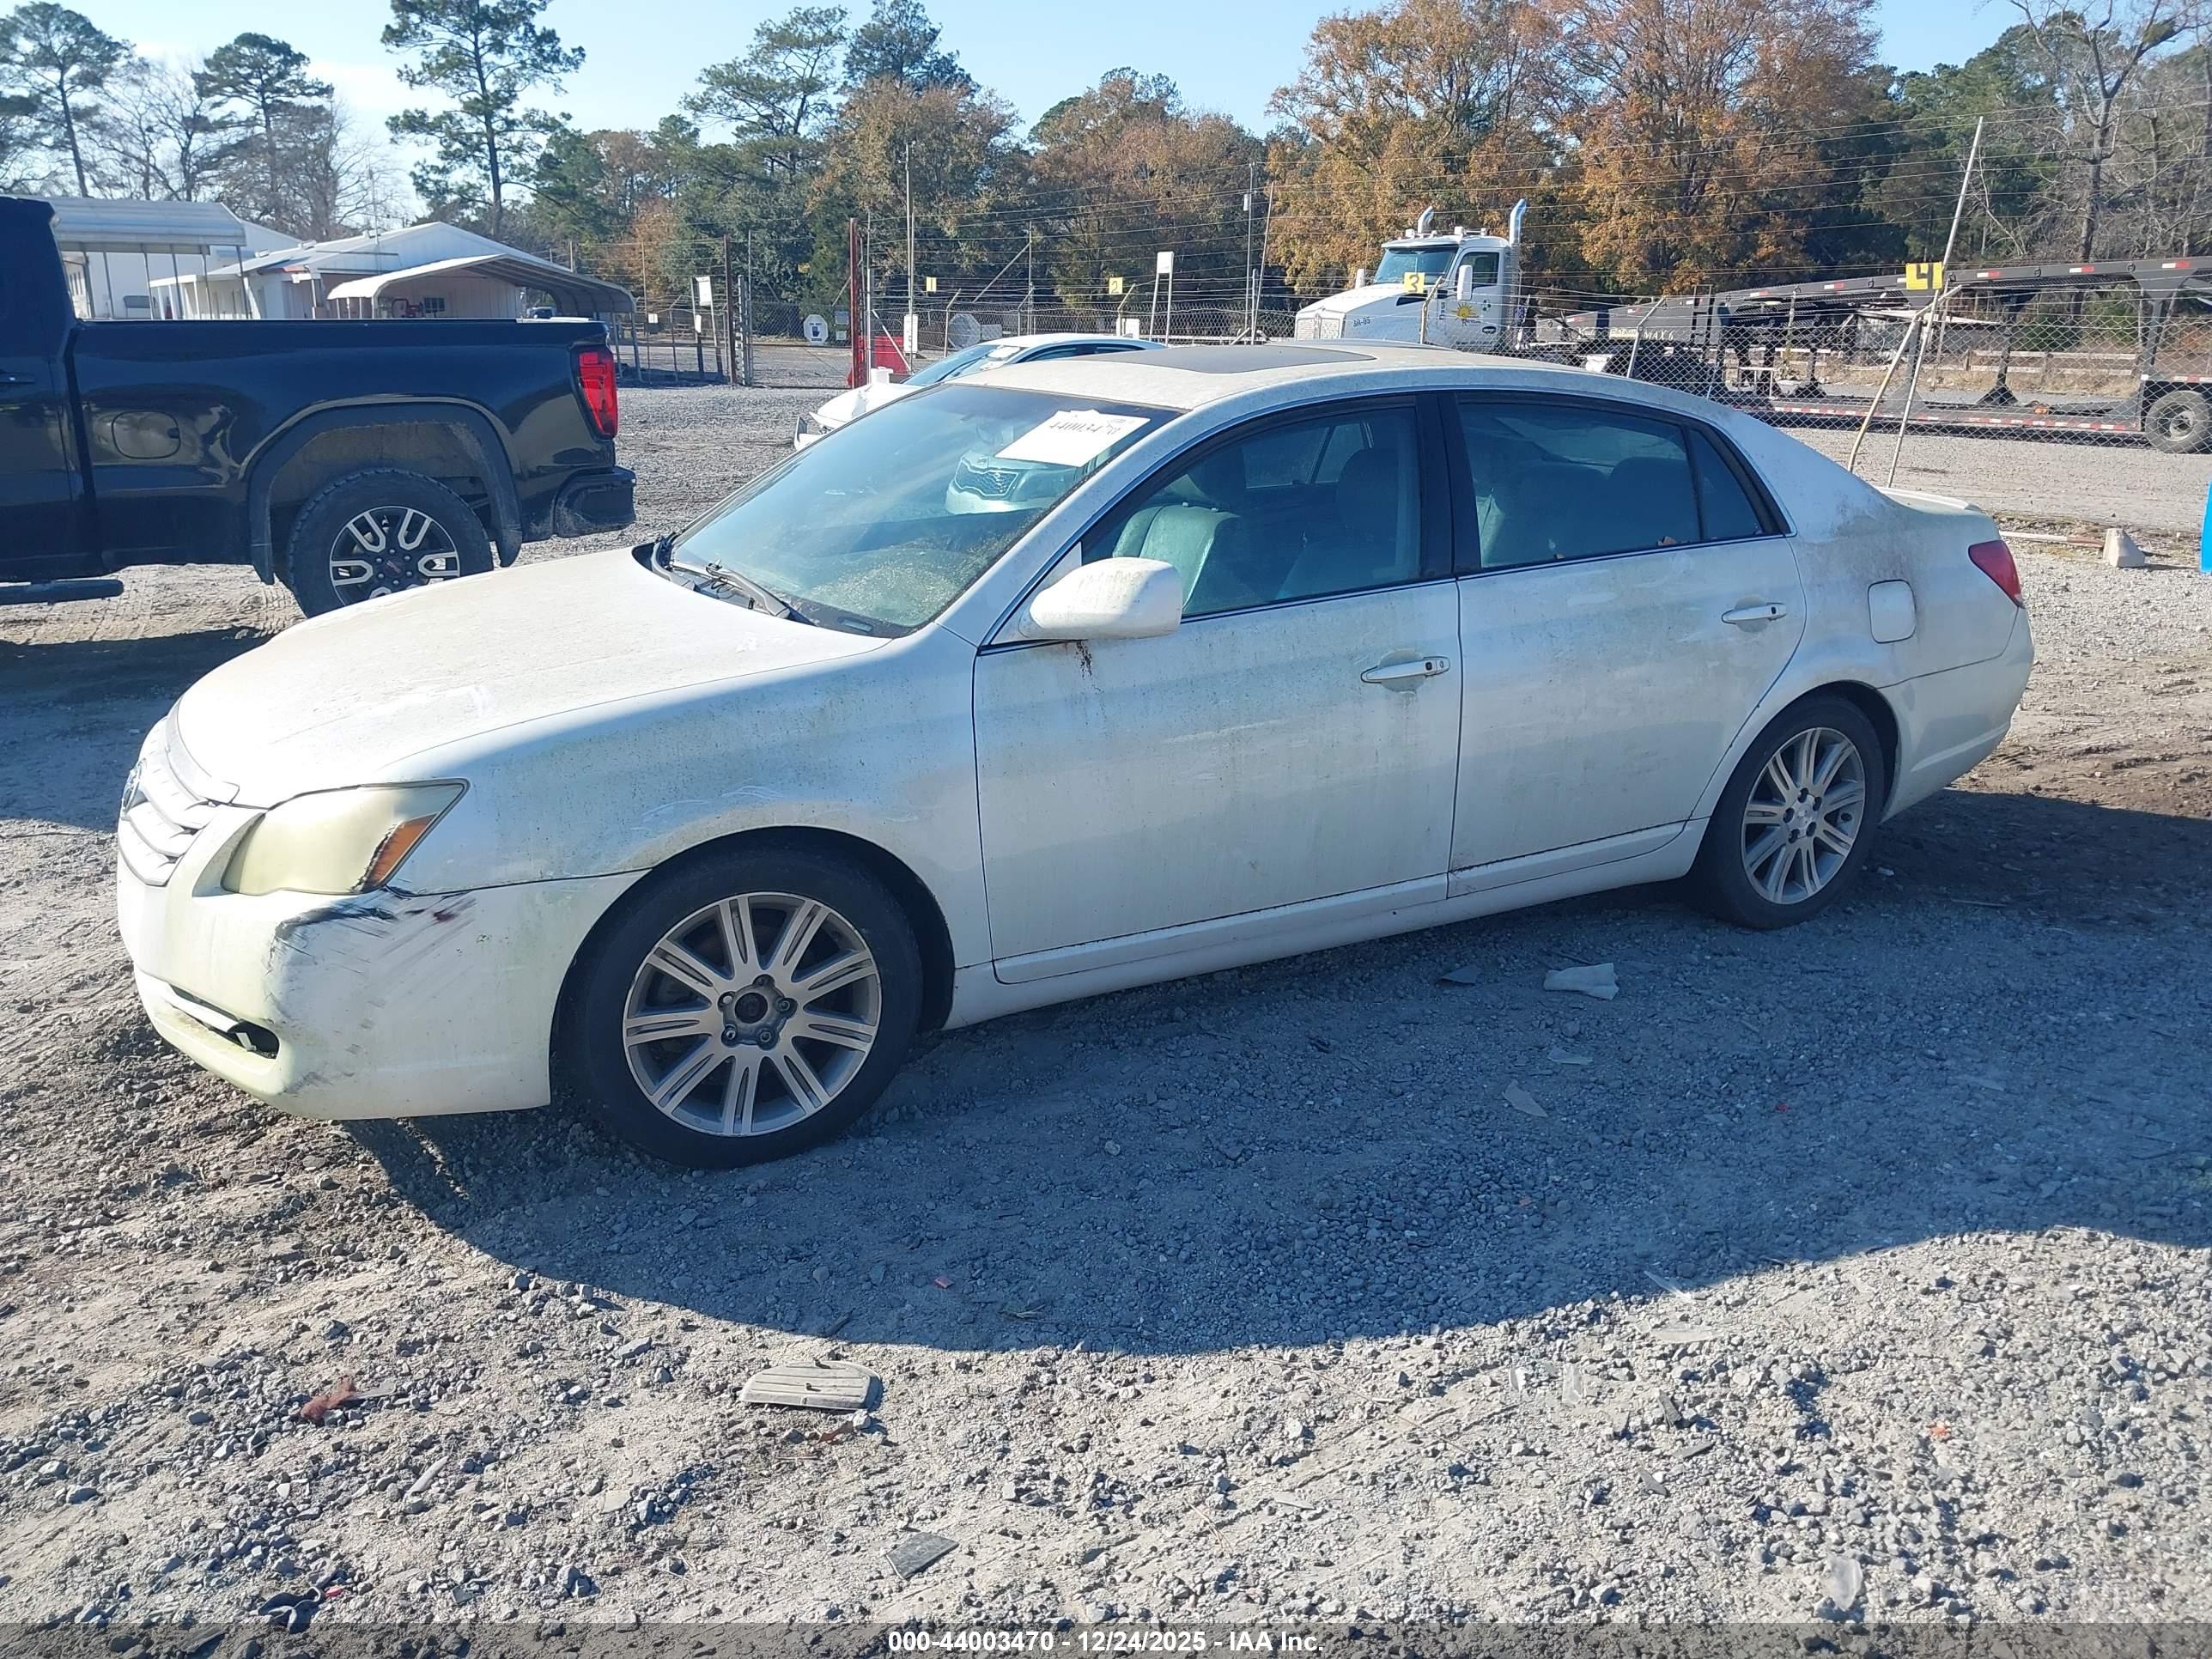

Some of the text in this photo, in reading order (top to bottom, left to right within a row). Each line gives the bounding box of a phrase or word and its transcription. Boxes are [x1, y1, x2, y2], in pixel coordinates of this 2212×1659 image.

[1407, 274, 1419, 293] 3
[1916, 263, 1934, 289] 4
[1111, 280, 1119, 293] 2
[1643, 329, 1668, 341] MAX
